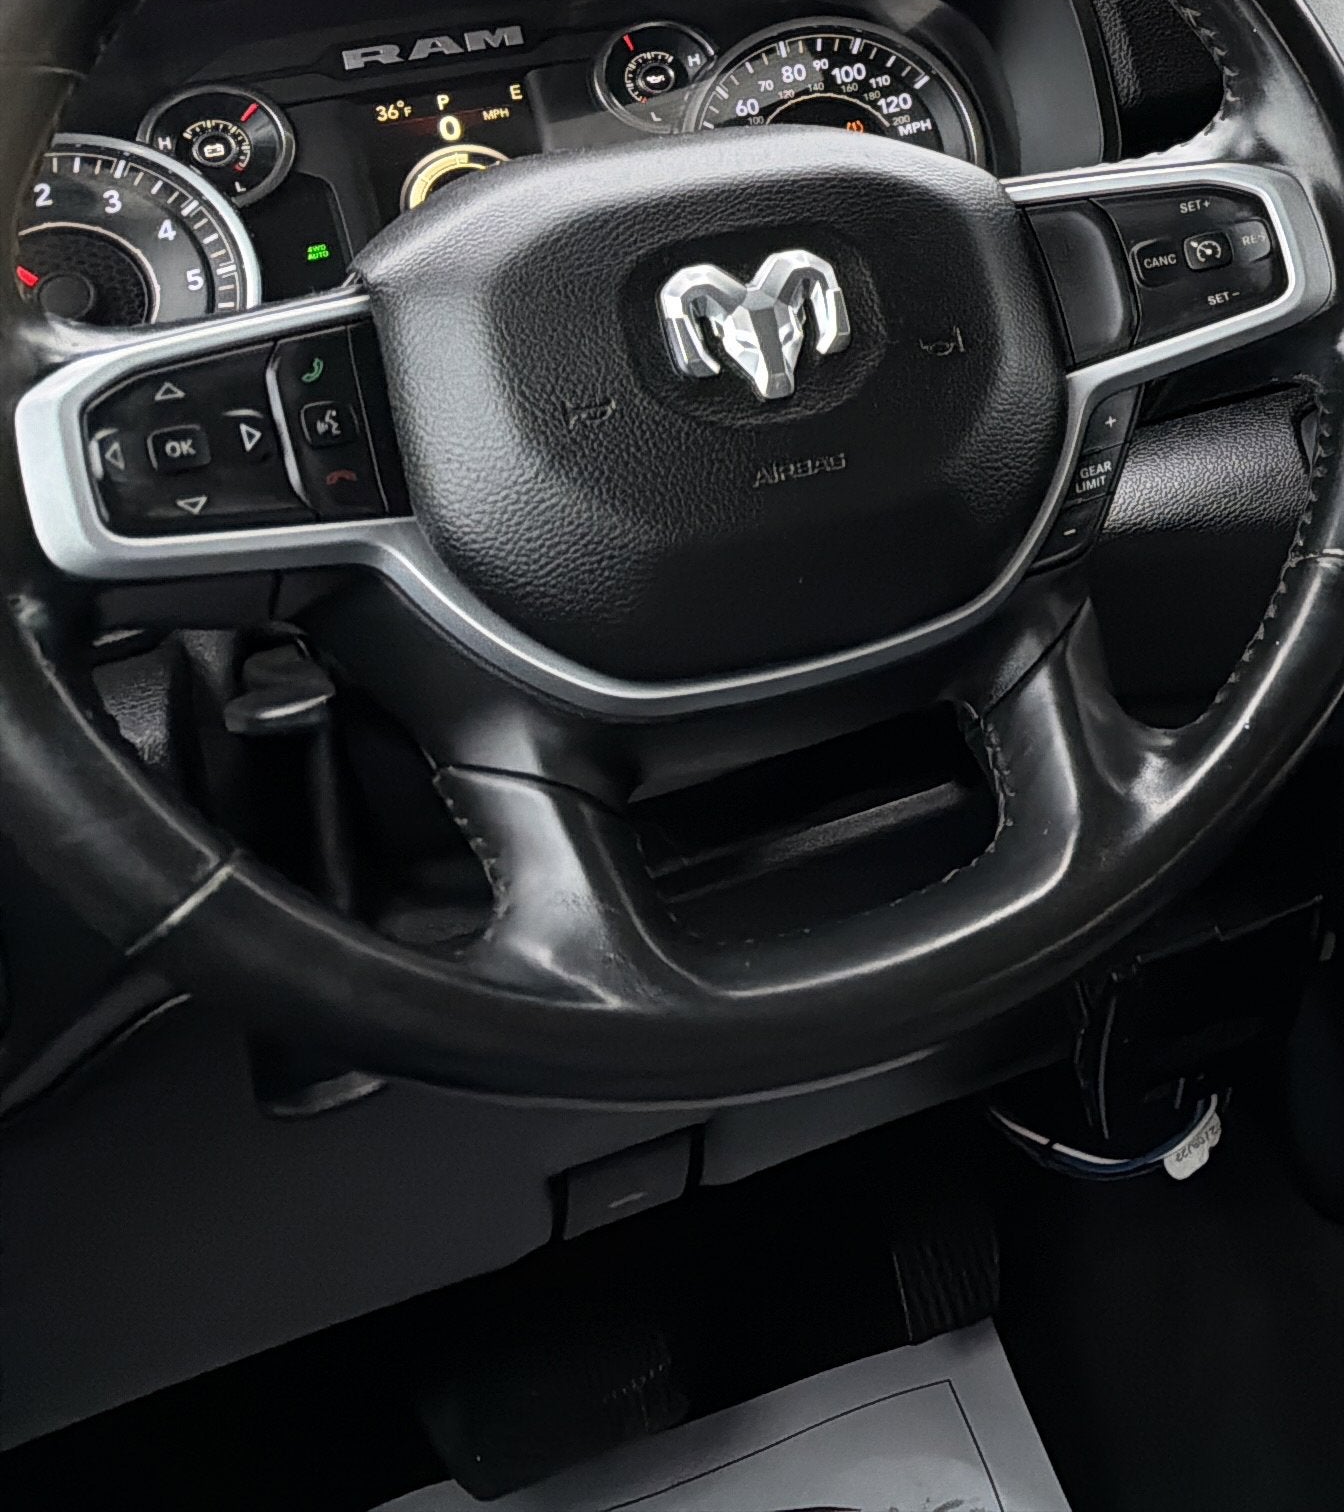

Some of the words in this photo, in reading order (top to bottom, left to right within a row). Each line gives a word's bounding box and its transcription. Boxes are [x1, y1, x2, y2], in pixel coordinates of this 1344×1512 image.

[342, 25, 524, 71] RAM
[687, 54, 701, 66] H
[813, 58, 829, 71] 90
[781, 64, 806, 83] 80
[831, 63, 866, 85] 100
[869, 74, 891, 89] 110
[509, 84, 523, 100] E
[758, 80, 774, 92] 70
[437, 95, 450, 111] P
[736, 99, 759, 117] 60
[877, 92, 912, 115] 120
[482, 107, 510, 122] MPH
[439, 116, 461, 140] 0
[898, 119, 932, 136] MPH
[158, 137, 172, 150] H
[33, 183, 53, 207] 2
[103, 189, 122, 213] 3
[158, 219, 176, 240] 4
[1144, 254, 1177, 269] CANC
[187, 269, 204, 291] 5
[165, 438, 196, 458] OK
[754, 452, 846, 488] AIRBAG
[1080, 460, 1112, 479] GEAR
[1075, 475, 1106, 493] LIMIT
